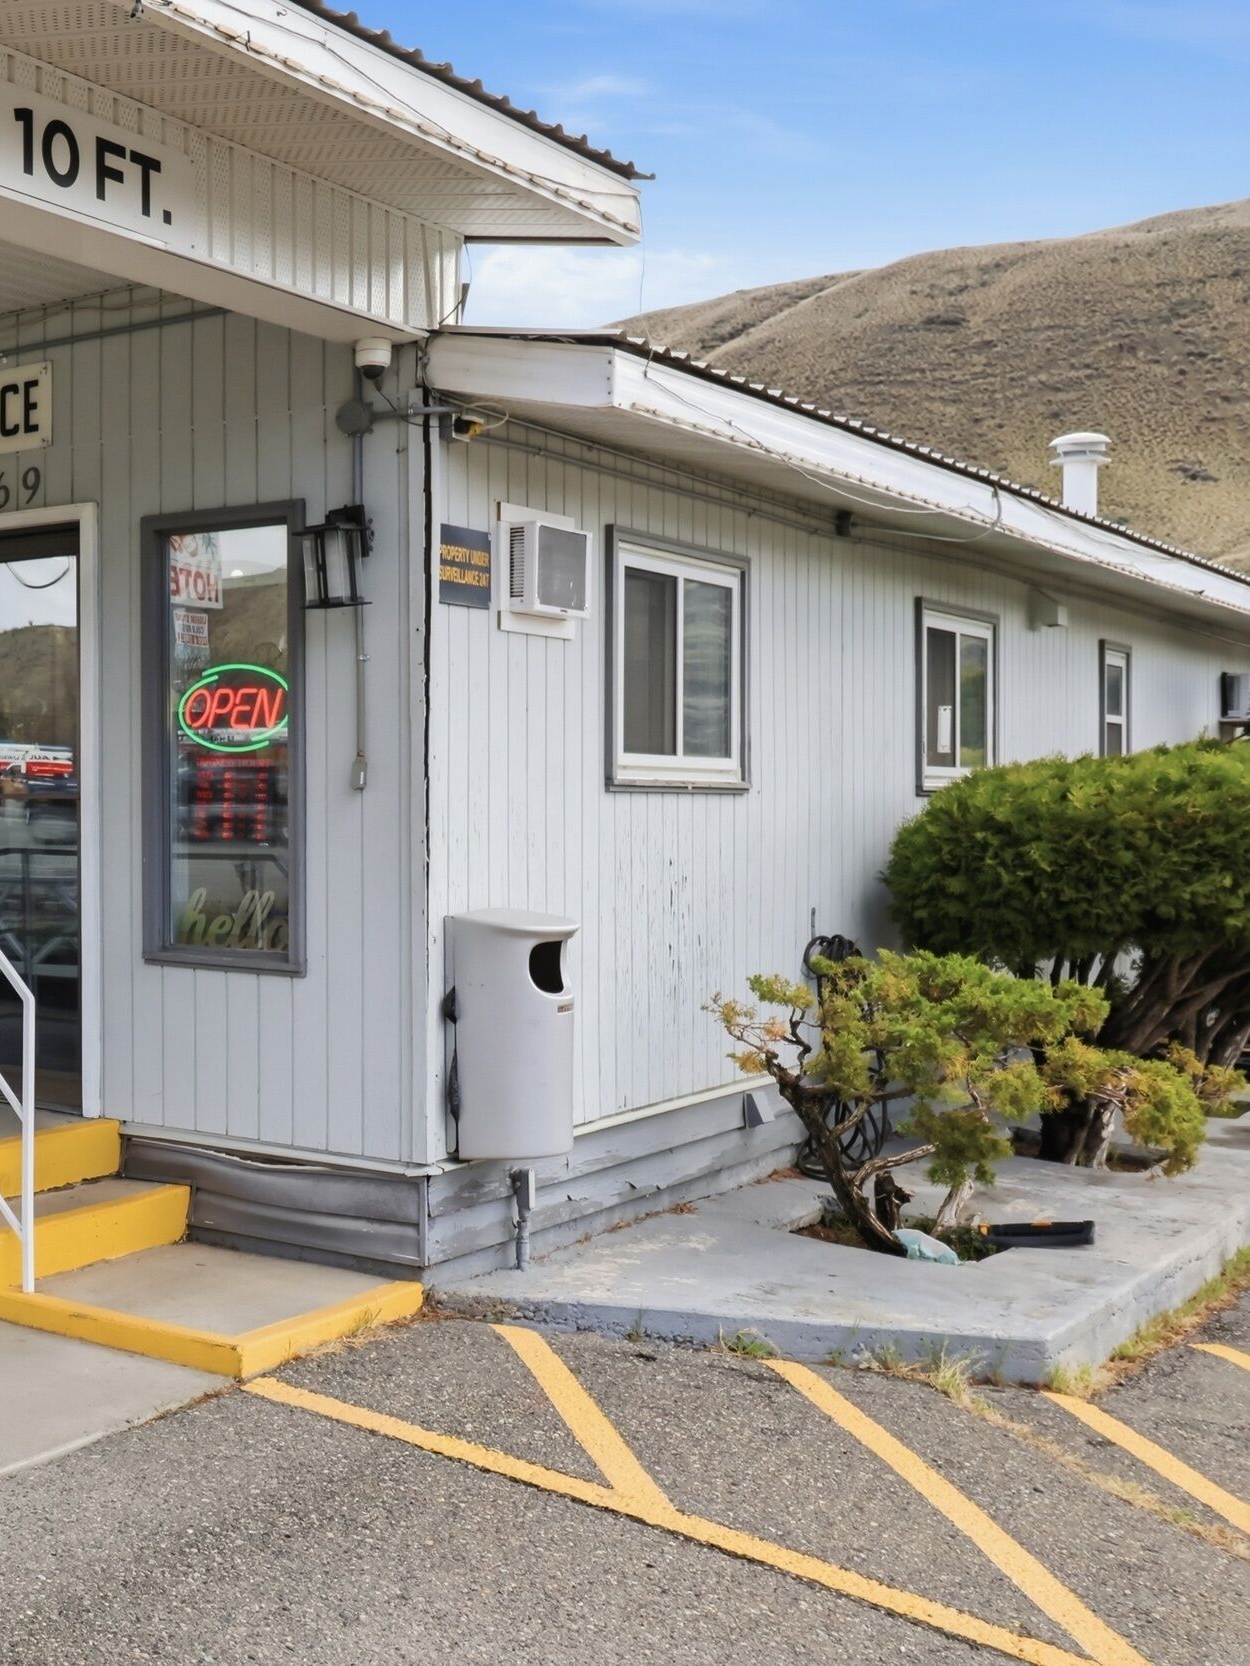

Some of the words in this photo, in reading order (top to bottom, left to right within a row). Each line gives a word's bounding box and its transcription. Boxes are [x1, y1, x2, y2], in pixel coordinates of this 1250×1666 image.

[14, 107, 80, 189] 10
[96, 135, 172, 226] FT.
[439, 565, 479, 586] SURVEILLANCE
[440, 543, 470, 563] PROPERTY
[470, 550, 489, 567] UNDER
[185, 687, 284, 729] OPEN
[177, 887, 288, 951] hello
